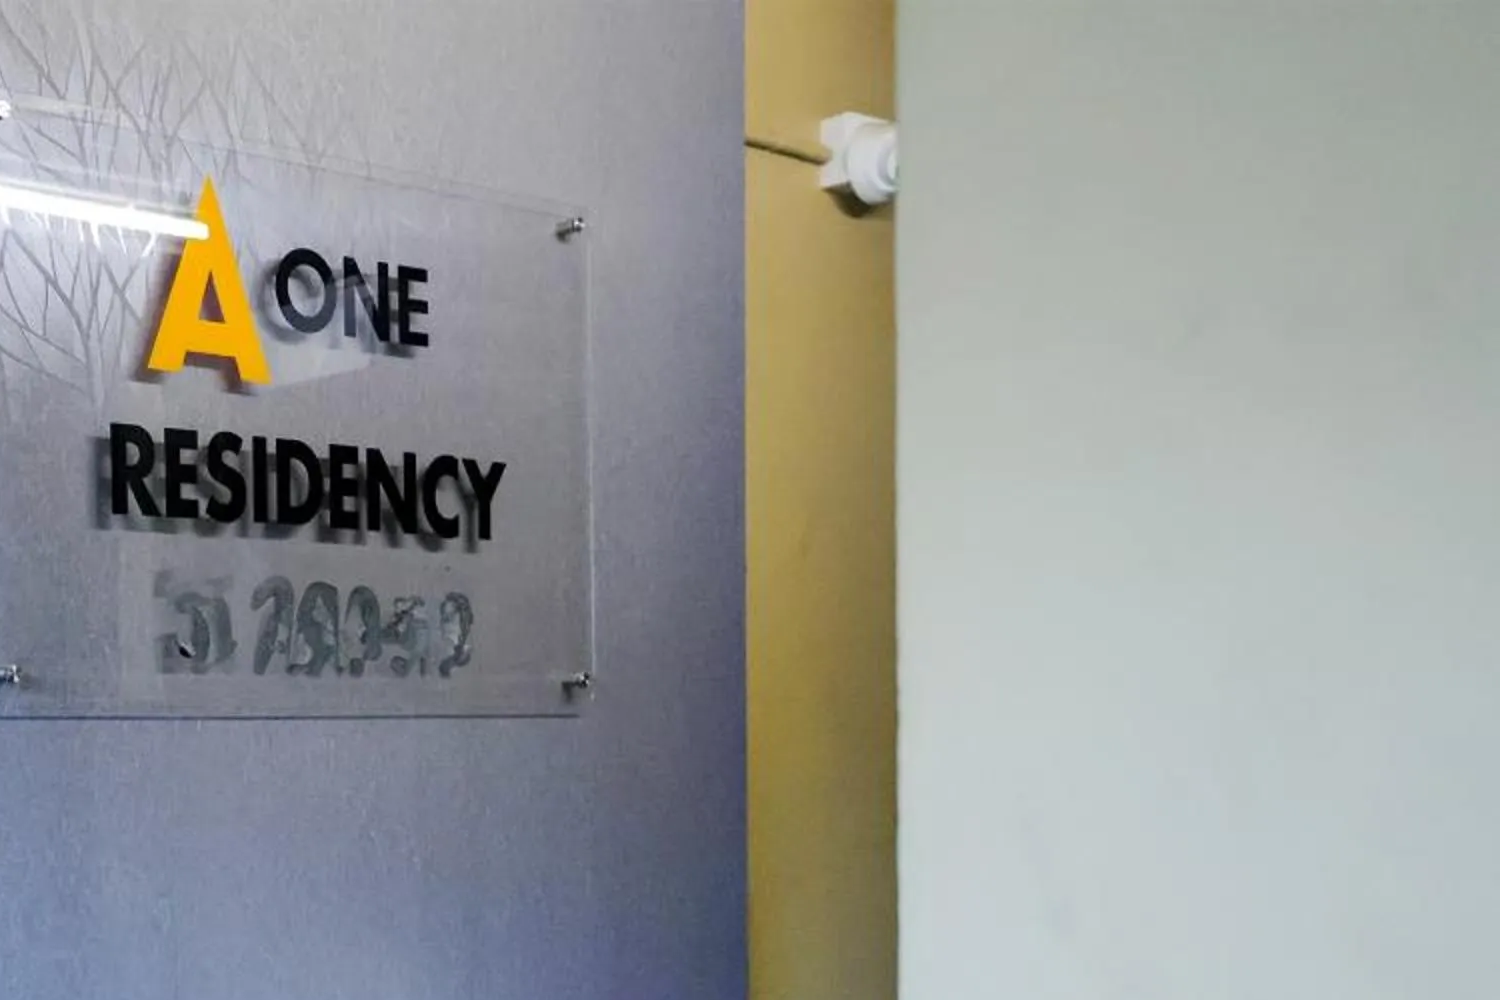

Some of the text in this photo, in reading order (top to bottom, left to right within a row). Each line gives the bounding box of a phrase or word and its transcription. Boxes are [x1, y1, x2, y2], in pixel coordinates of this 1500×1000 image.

[147, 175, 429, 385] A ONE
[109, 422, 507, 540] RESIDENCY
